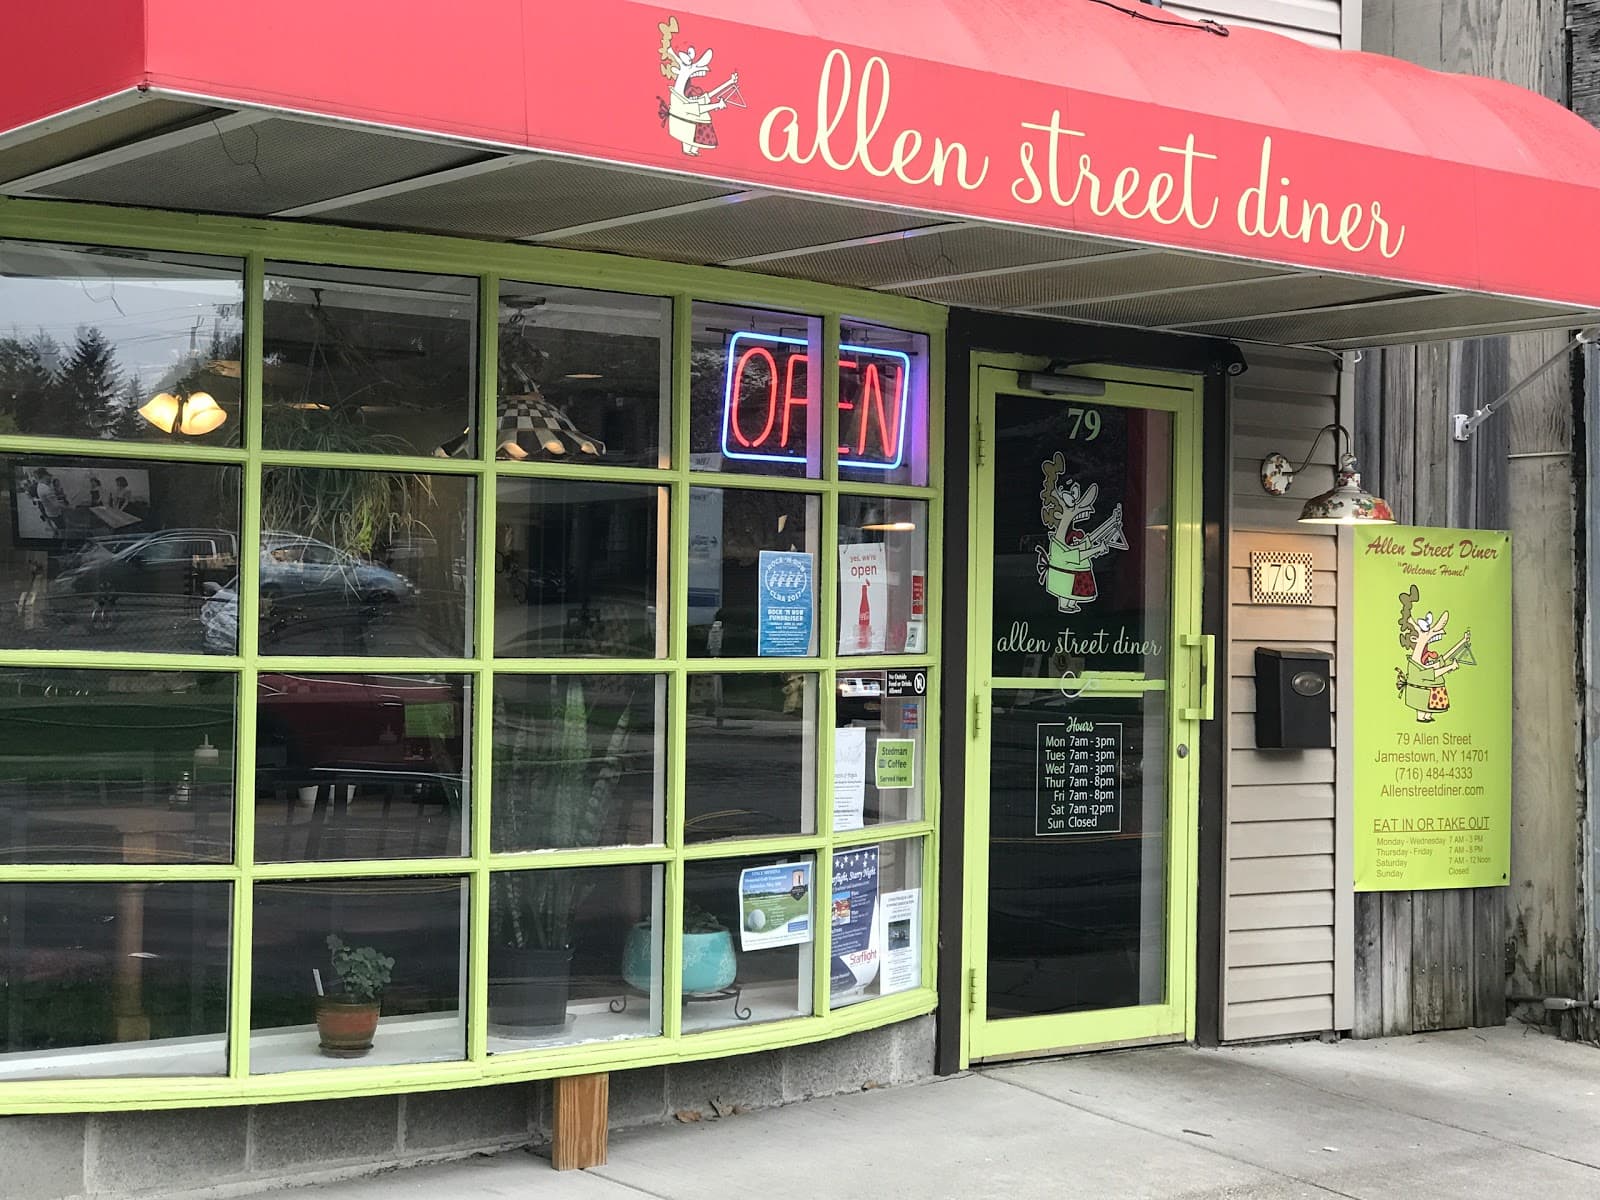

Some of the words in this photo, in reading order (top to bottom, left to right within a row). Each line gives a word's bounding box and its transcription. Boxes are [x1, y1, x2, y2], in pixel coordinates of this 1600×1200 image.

[759, 48, 989, 190] allen
[1011, 109, 1220, 229] street
[1235, 135, 1405, 258] diner
[1067, 408, 1101, 441] 79
[1365, 536, 1406, 555] Allen
[1411, 537, 1454, 558] Street
[1459, 540, 1498, 559] Diner
[851, 565, 877, 578] open
[1398, 562, 1436, 576] "Welcome
[1270, 563, 1297, 592] 79
[997, 621, 1051, 653] allen
[1055, 628, 1110, 655] street
[1113, 626, 1162, 656] diner
[1066, 716, 1094, 733] Hours
[1046, 736, 1065, 746] Mon
[1070, 736, 1088, 746] 7am
[1095, 736, 1115, 748] 3pm
[1397, 733, 1409, 745] 79
[1413, 733, 1438, 745] Allen
[1442, 733, 1471, 745] Street
[882, 747, 908, 756] Stedman
[1046, 750, 1066, 760] Tues
[1070, 750, 1088, 760] 7am
[1095, 750, 1115, 762] 3pm
[1375, 750, 1438, 763] Jamestown,
[1442, 750, 1457, 761] NY
[1461, 750, 1488, 761] 14701
[888, 760, 907, 769] Coffee
[1046, 764, 1065, 774] Wed
[1069, 763, 1088, 773] 7am
[1095, 764, 1115, 775] 3pm
[1395, 768, 1423, 782] (716)
[1426, 767, 1472, 779] 484-4333
[1045, 777, 1065, 788] Thur
[1069, 776, 1088, 787] 7am
[1094, 776, 1114, 789] 8pm
[1054, 790, 1064, 801] Fri
[1069, 790, 1088, 800] 7am
[1094, 790, 1114, 802] 8pm
[1381, 785, 1484, 797] Allenstreetdiner.com
[1051, 804, 1064, 815] Sat
[1069, 804, 1088, 814] 7am
[1048, 818, 1064, 829] Sun
[1068, 816, 1097, 828] Closed
[1374, 819, 1398, 831] EAT
[1402, 819, 1413, 830] IN
[1417, 818, 1434, 830] OR
[1438, 818, 1465, 830] TAKE
[1468, 817, 1490, 829] OUT
[1377, 838, 1404, 846] Monday
[1410, 837, 1445, 845] Wednesday
[1377, 849, 1408, 857] Thursday
[1414, 848, 1432, 856] Friday
[1376, 860, 1407, 868] Saturday
[1377, 870, 1403, 878] Sunday
[1449, 867, 1469, 875] Closed
[850, 949, 877, 965] Starflight
